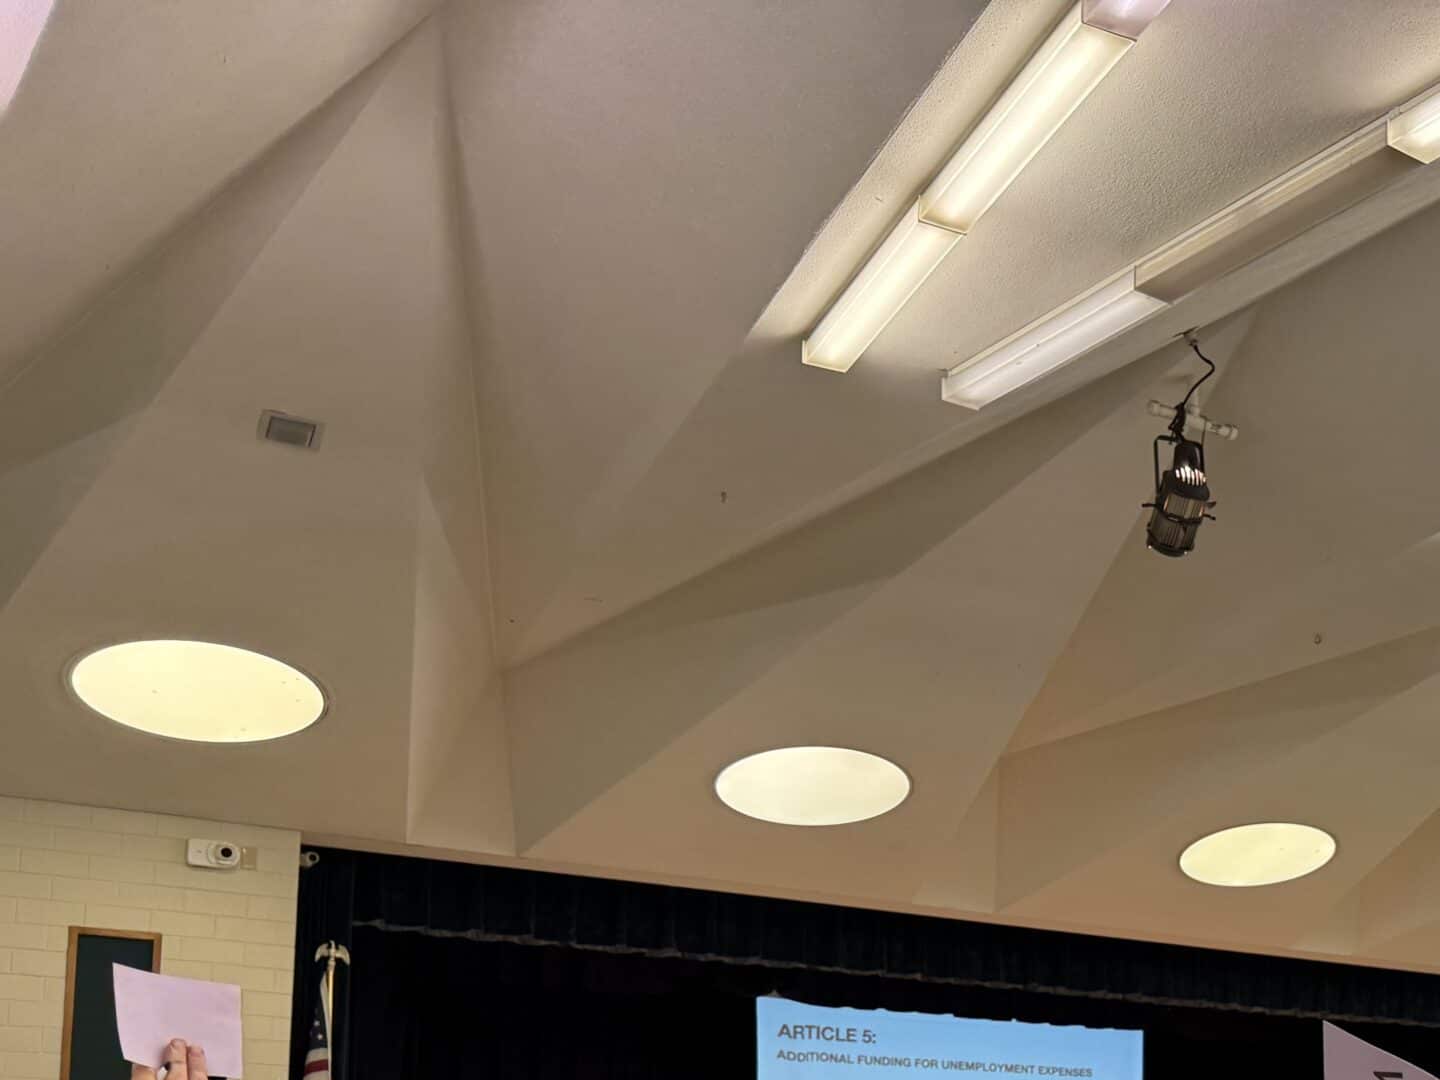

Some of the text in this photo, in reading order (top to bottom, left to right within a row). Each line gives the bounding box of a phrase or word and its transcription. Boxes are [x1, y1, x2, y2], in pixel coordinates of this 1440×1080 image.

[777, 1024, 877, 1044] ARTICLE 5:
[777, 1049, 1093, 1078] ADDITIONAL FUNDING FOR UNEMPLOYMENT EXPENSES
